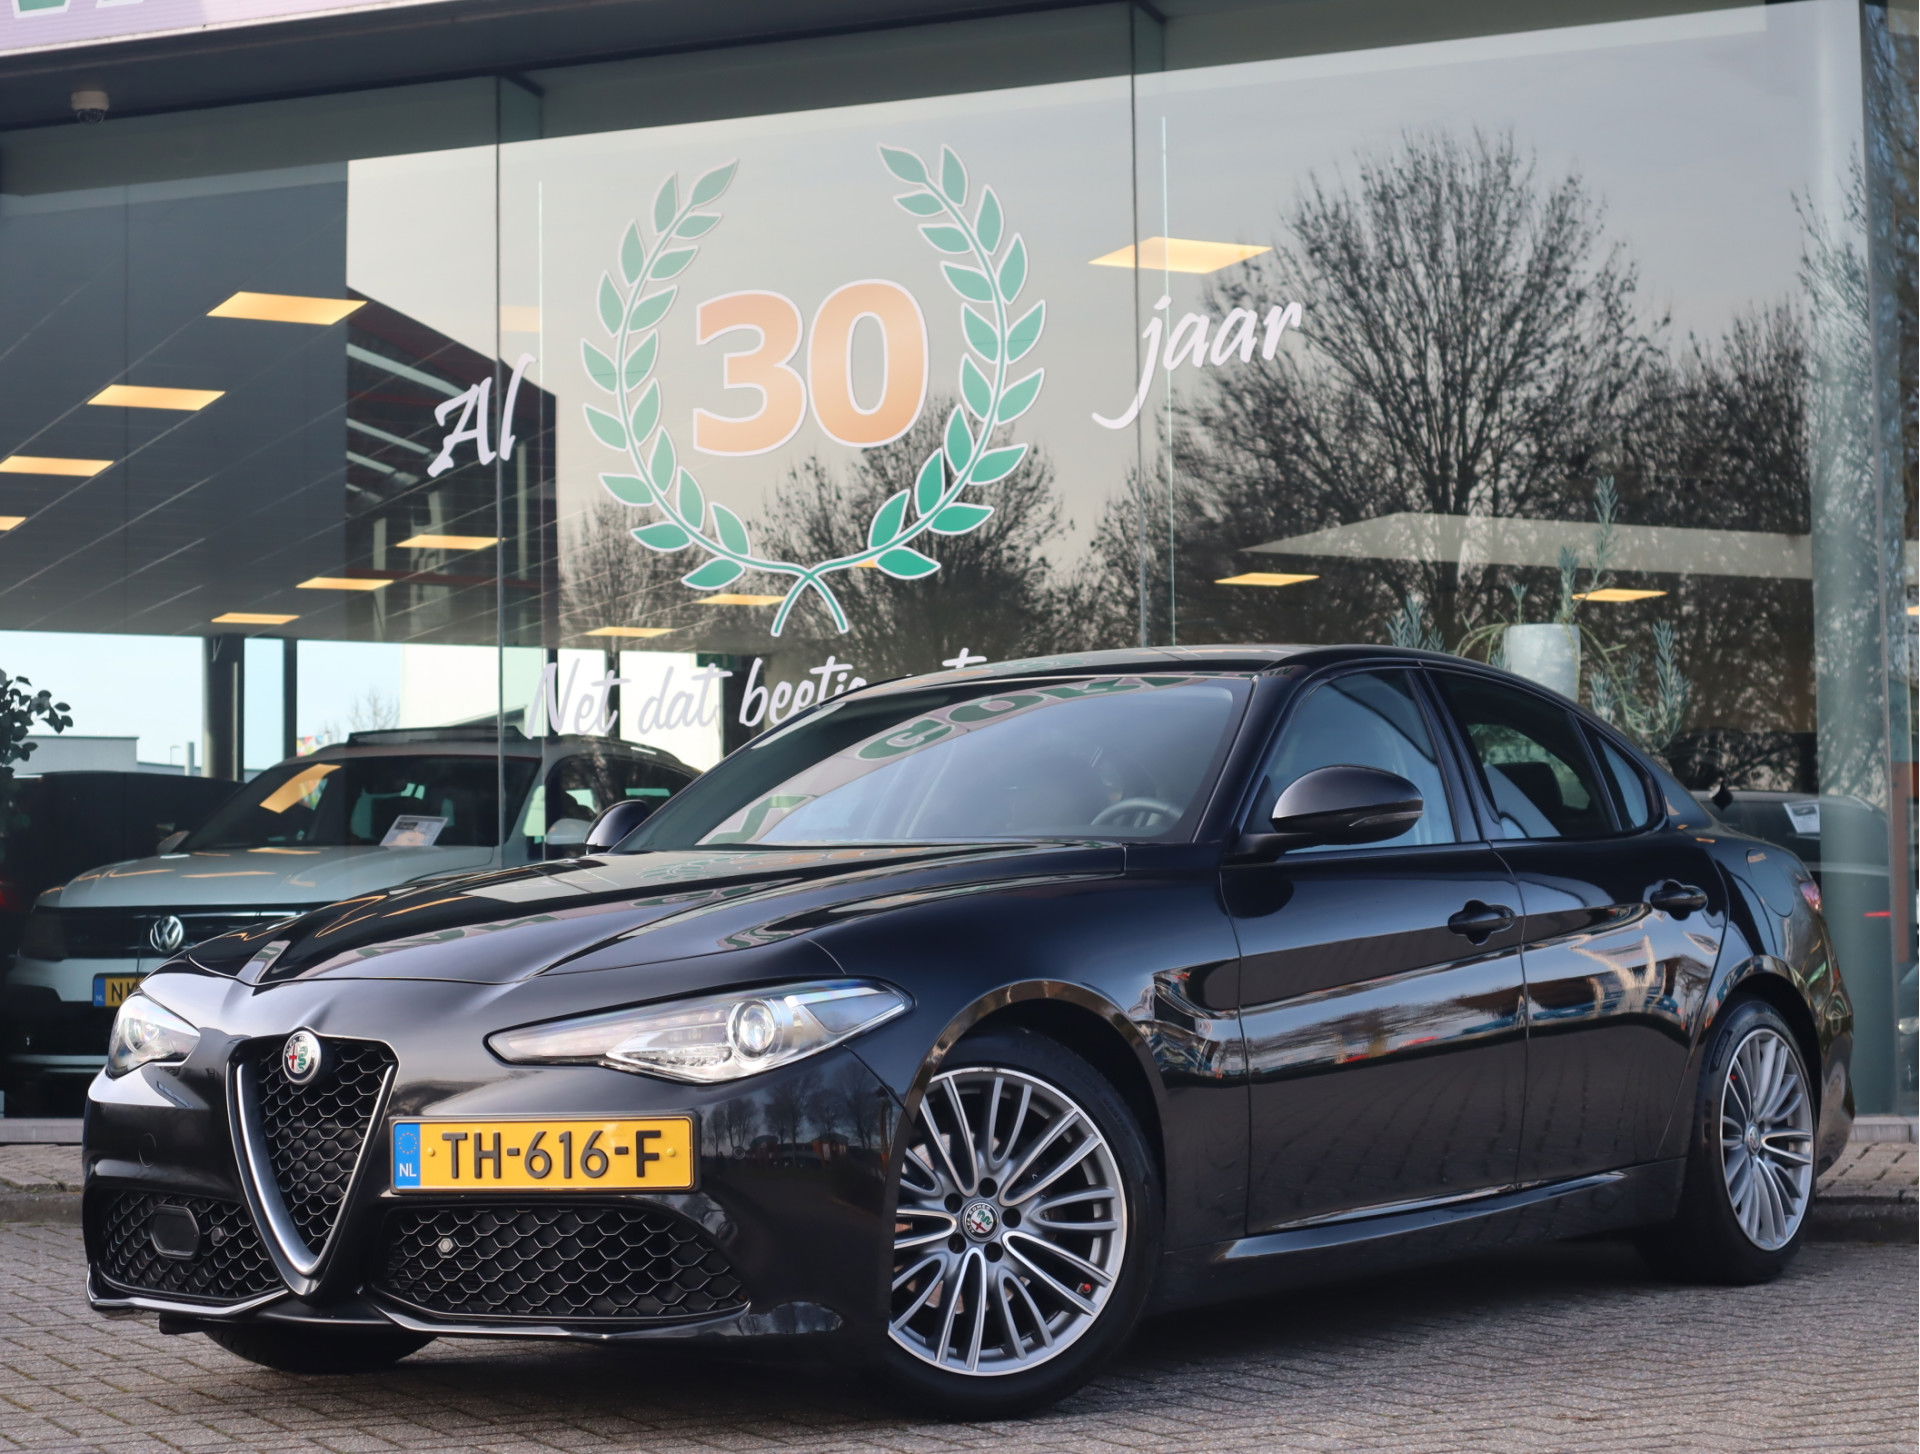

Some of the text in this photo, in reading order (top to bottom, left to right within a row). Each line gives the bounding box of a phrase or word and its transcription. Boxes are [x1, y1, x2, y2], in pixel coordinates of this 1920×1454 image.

[427, 279, 1302, 478] Al 30 jaar
[527, 658, 631, 739] Net
[638, 663, 733, 735] dat
[399, 1163, 417, 1177] NL
[442, 1130, 662, 1179] TH-616-F
